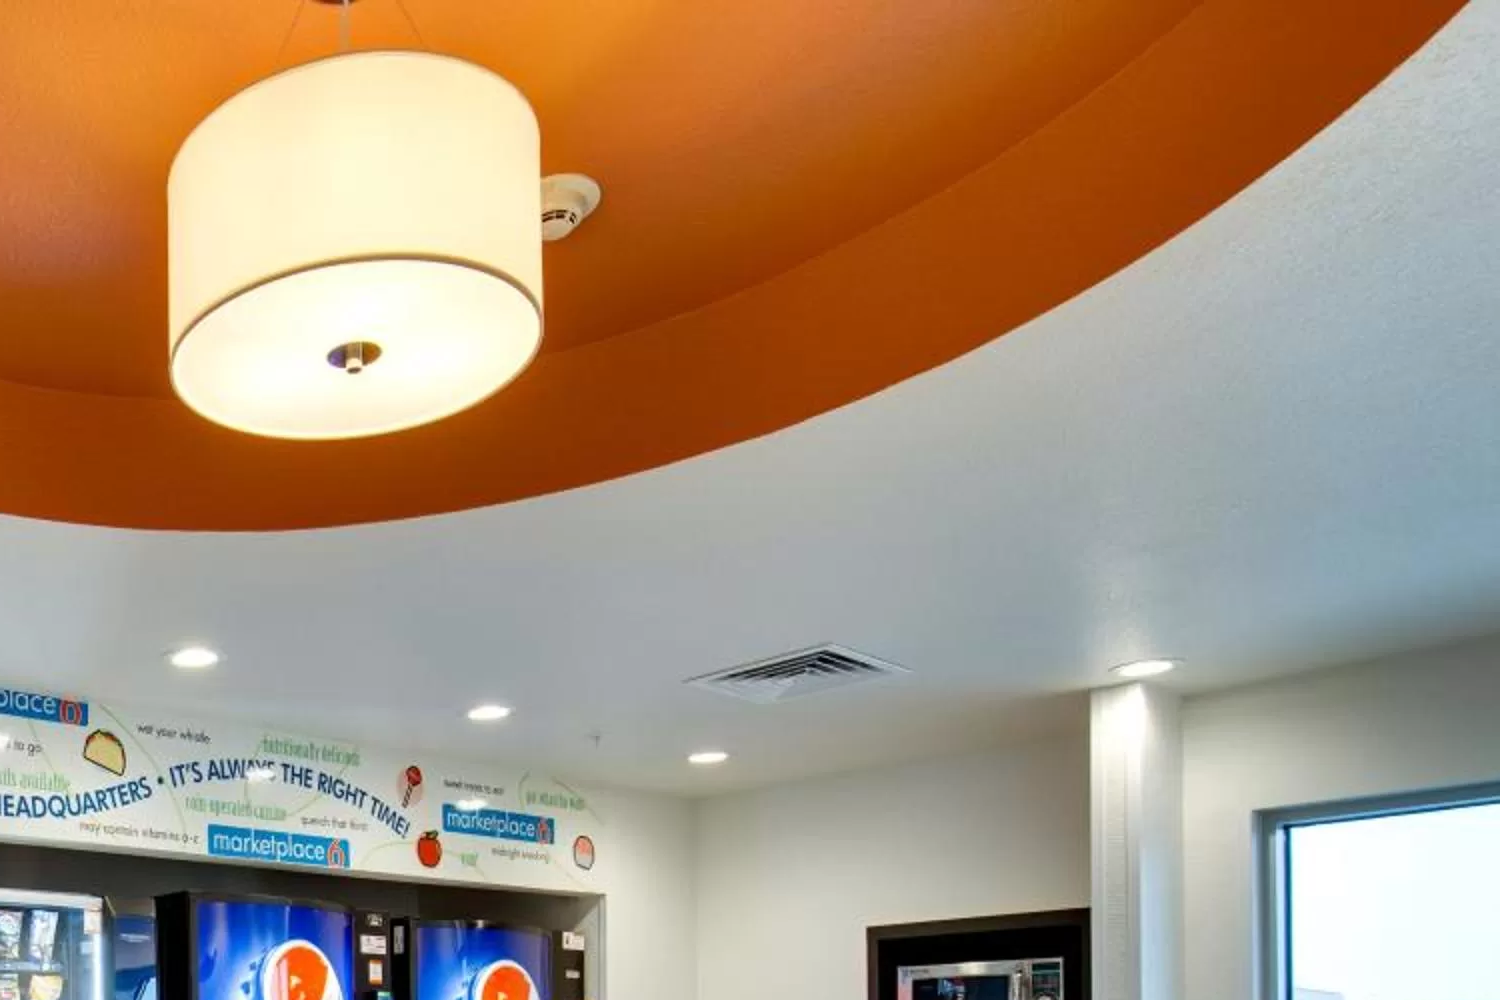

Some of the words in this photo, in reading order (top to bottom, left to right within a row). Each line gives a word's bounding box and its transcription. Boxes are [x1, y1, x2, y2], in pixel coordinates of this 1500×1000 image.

[169, 761, 203, 788] IT'S
[281, 763, 313, 788] THE
[317, 775, 368, 809] RIGHT
[371, 796, 412, 839] TIME!
